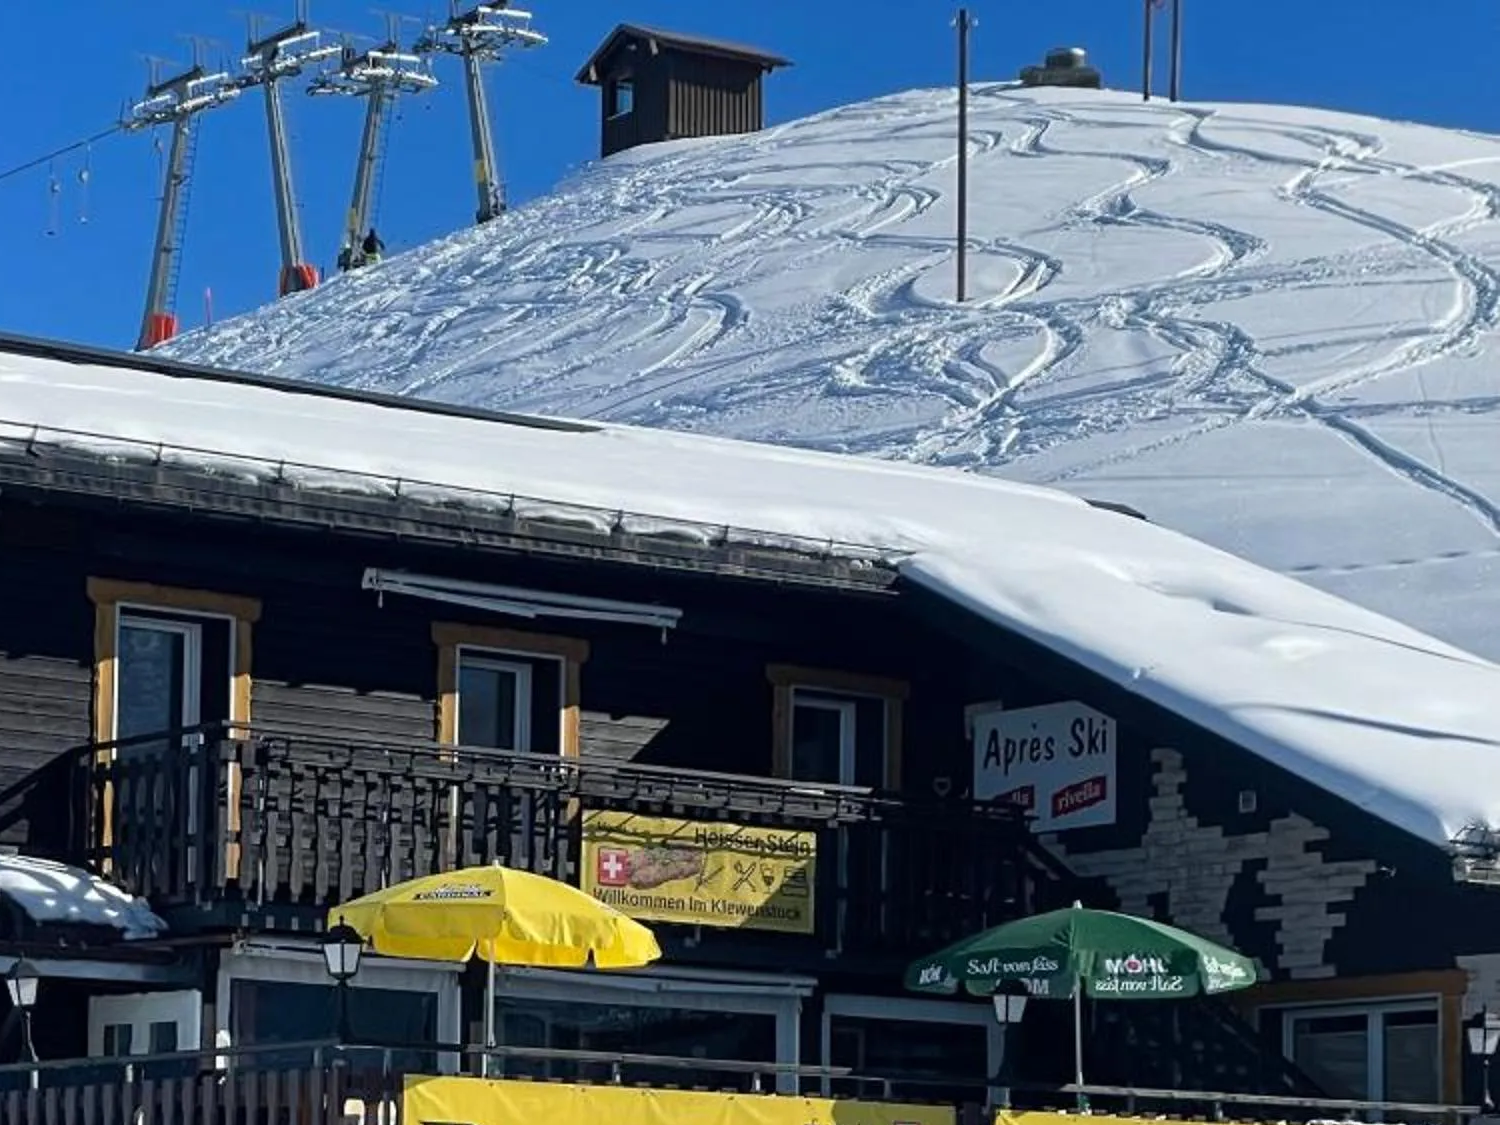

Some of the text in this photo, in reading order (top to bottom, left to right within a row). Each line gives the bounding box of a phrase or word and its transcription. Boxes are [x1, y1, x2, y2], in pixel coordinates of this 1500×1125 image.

[983, 717, 1107, 776] Après Ski
[593, 887, 686, 911] Willkommen
